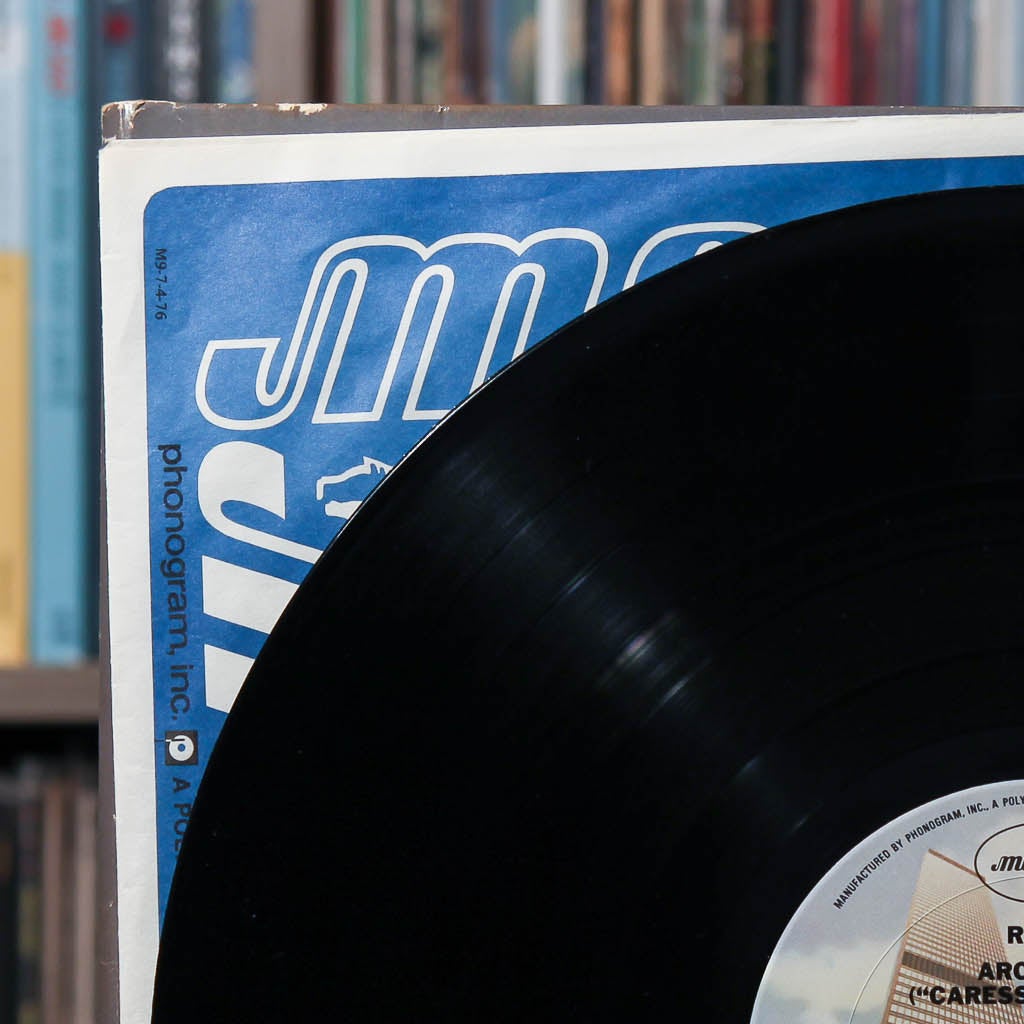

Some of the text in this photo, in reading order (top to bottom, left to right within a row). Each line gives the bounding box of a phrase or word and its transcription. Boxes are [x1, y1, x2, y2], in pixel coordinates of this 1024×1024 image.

[154, 248, 168, 321] M9-7-4-76
[158, 443, 194, 721] phonogram, inc.
[173, 777, 191, 794] A
[833, 849, 892, 910] MANUFACTURED
[890, 839, 904, 853] BY
[904, 809, 966, 843] PHONOGRAM,
[992, 799, 1000, 809] A
